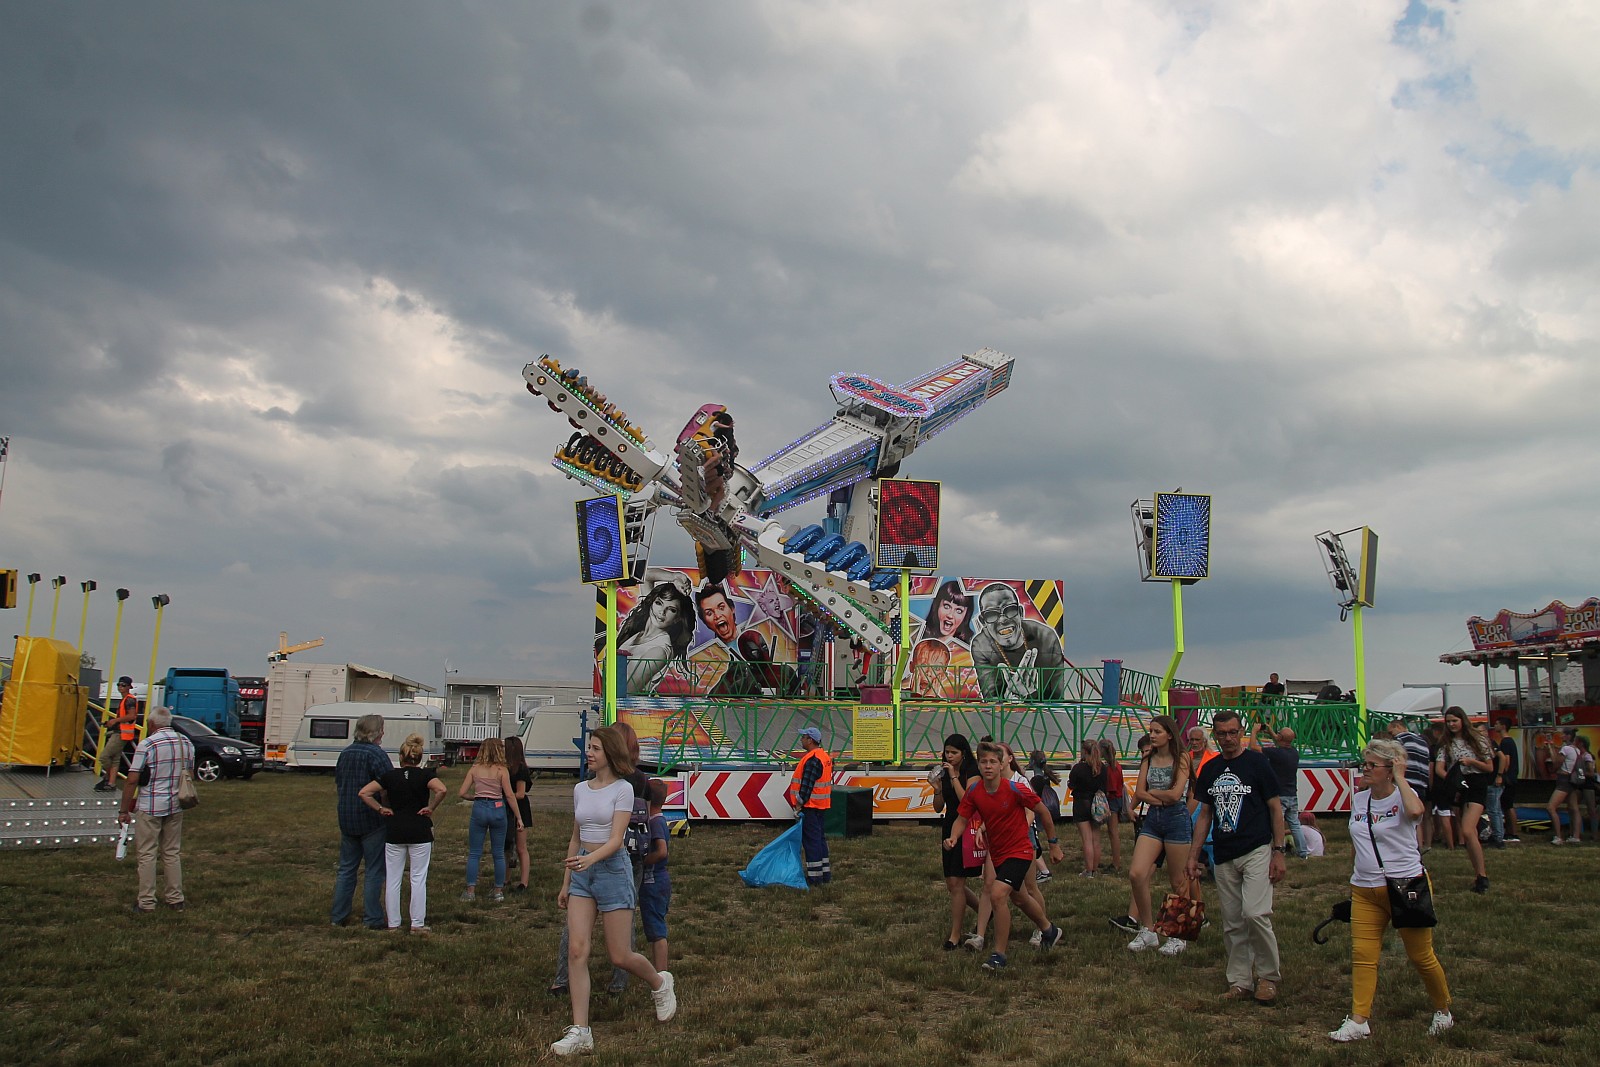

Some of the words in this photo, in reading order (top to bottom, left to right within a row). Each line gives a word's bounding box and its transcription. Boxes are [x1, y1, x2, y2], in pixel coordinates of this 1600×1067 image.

[842, 377, 875, 391] TOP
[736, 515, 747, 524] 2
[1565, 611, 1593, 623] TOP
[1481, 624, 1504, 636] TOP
[1563, 621, 1598, 634] SCAN
[1478, 632, 1509, 644] SCAN
[1207, 784, 1252, 795] CHAMPIONS
